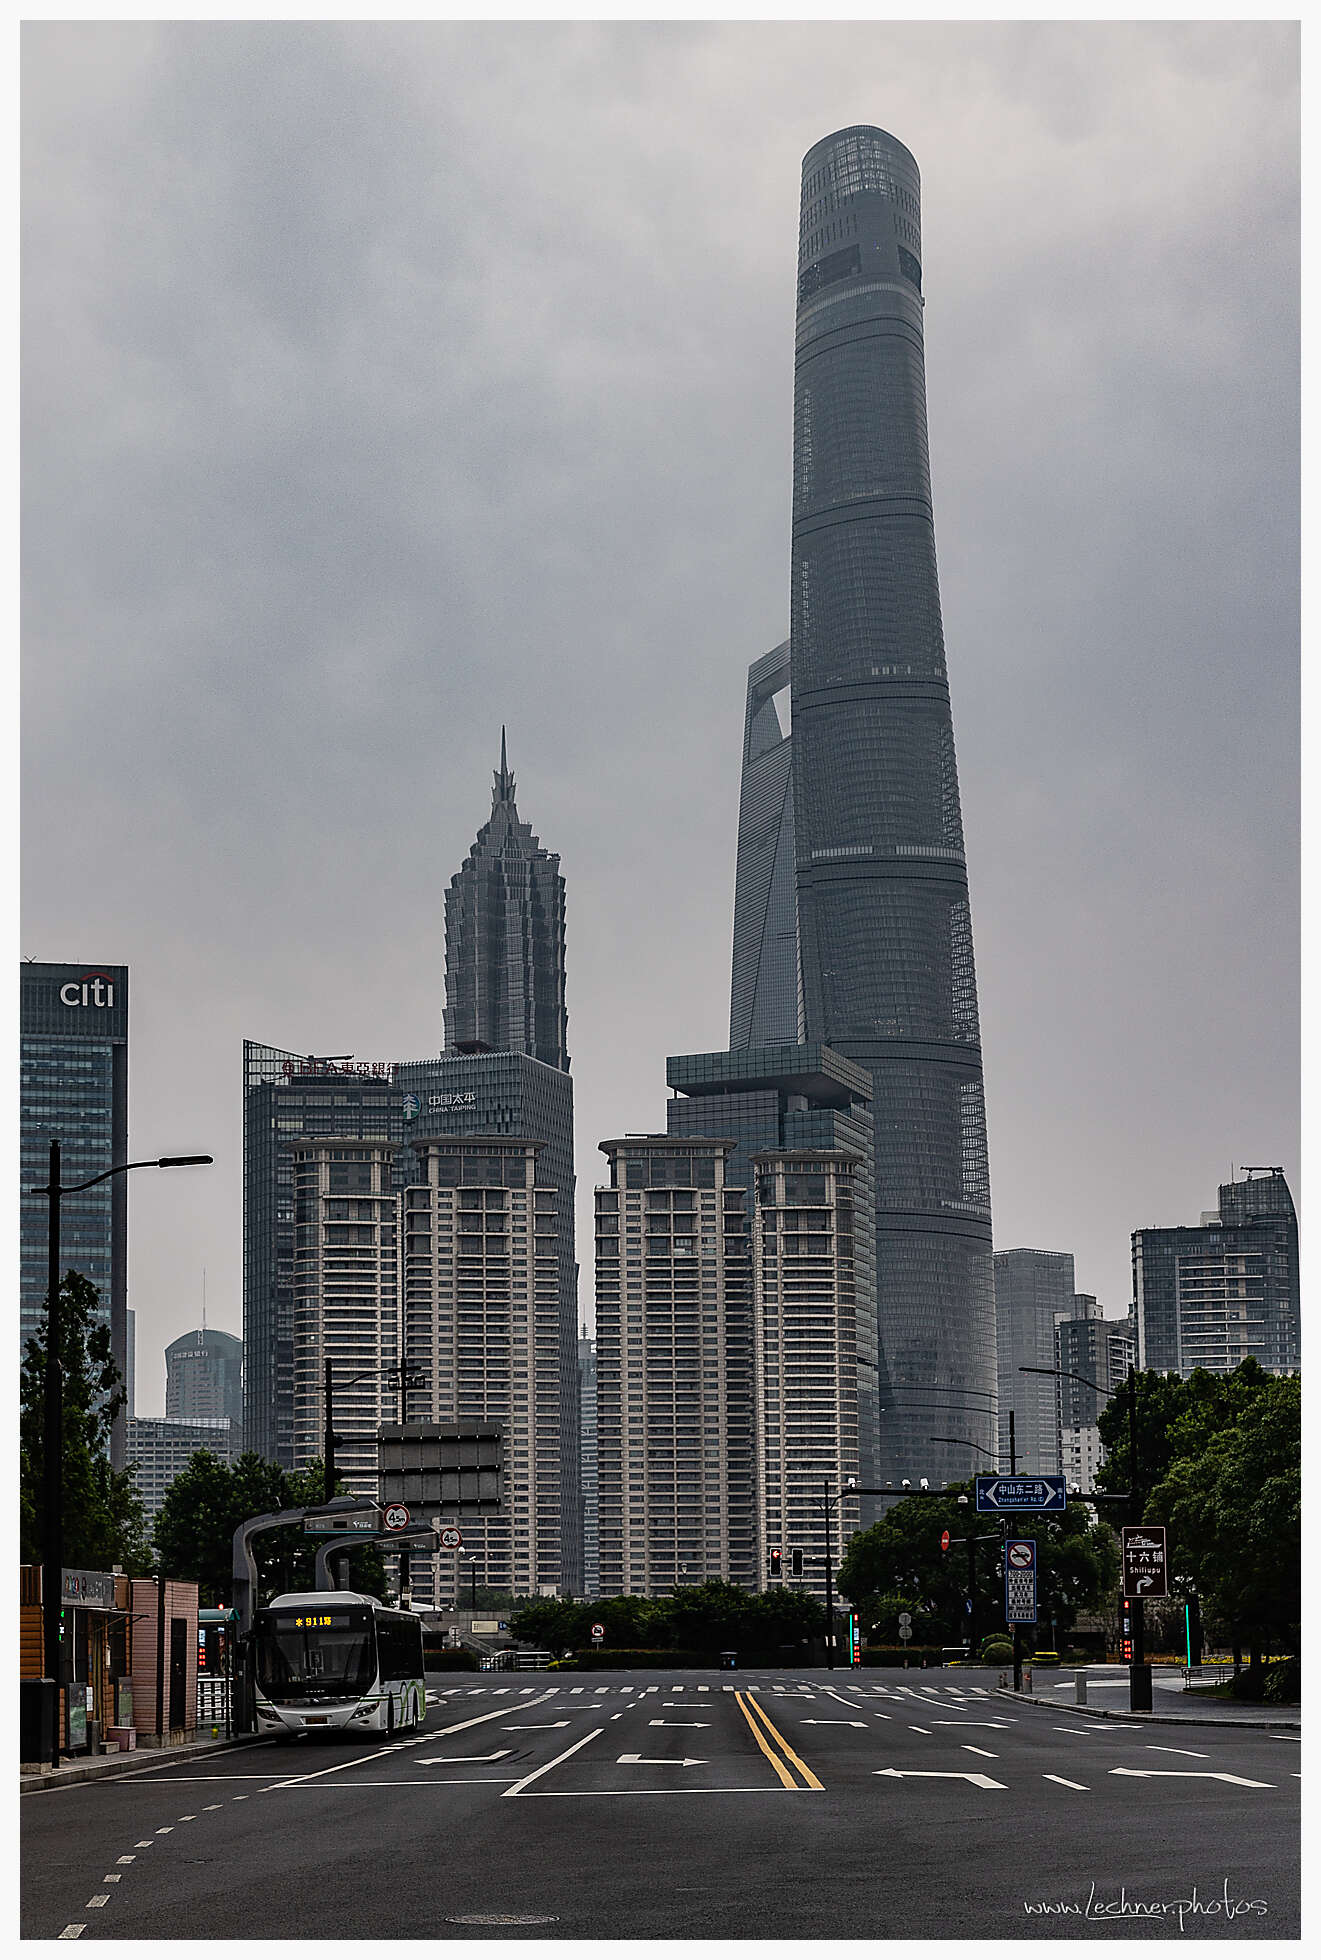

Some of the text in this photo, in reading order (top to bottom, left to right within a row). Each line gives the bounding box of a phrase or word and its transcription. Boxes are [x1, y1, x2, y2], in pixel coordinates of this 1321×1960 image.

[60, 978, 113, 1007] citi
[300, 1062, 339, 1075] BEA
[428, 1092, 476, 1107] 中国太平
[429, 1104, 477, 1114] CHINA TAIPING
[998, 1484, 1043, 1495] 中山东二路
[1126, 1551, 1164, 1563] 十六铺
[1129, 1566, 1161, 1574] Shiliupu
